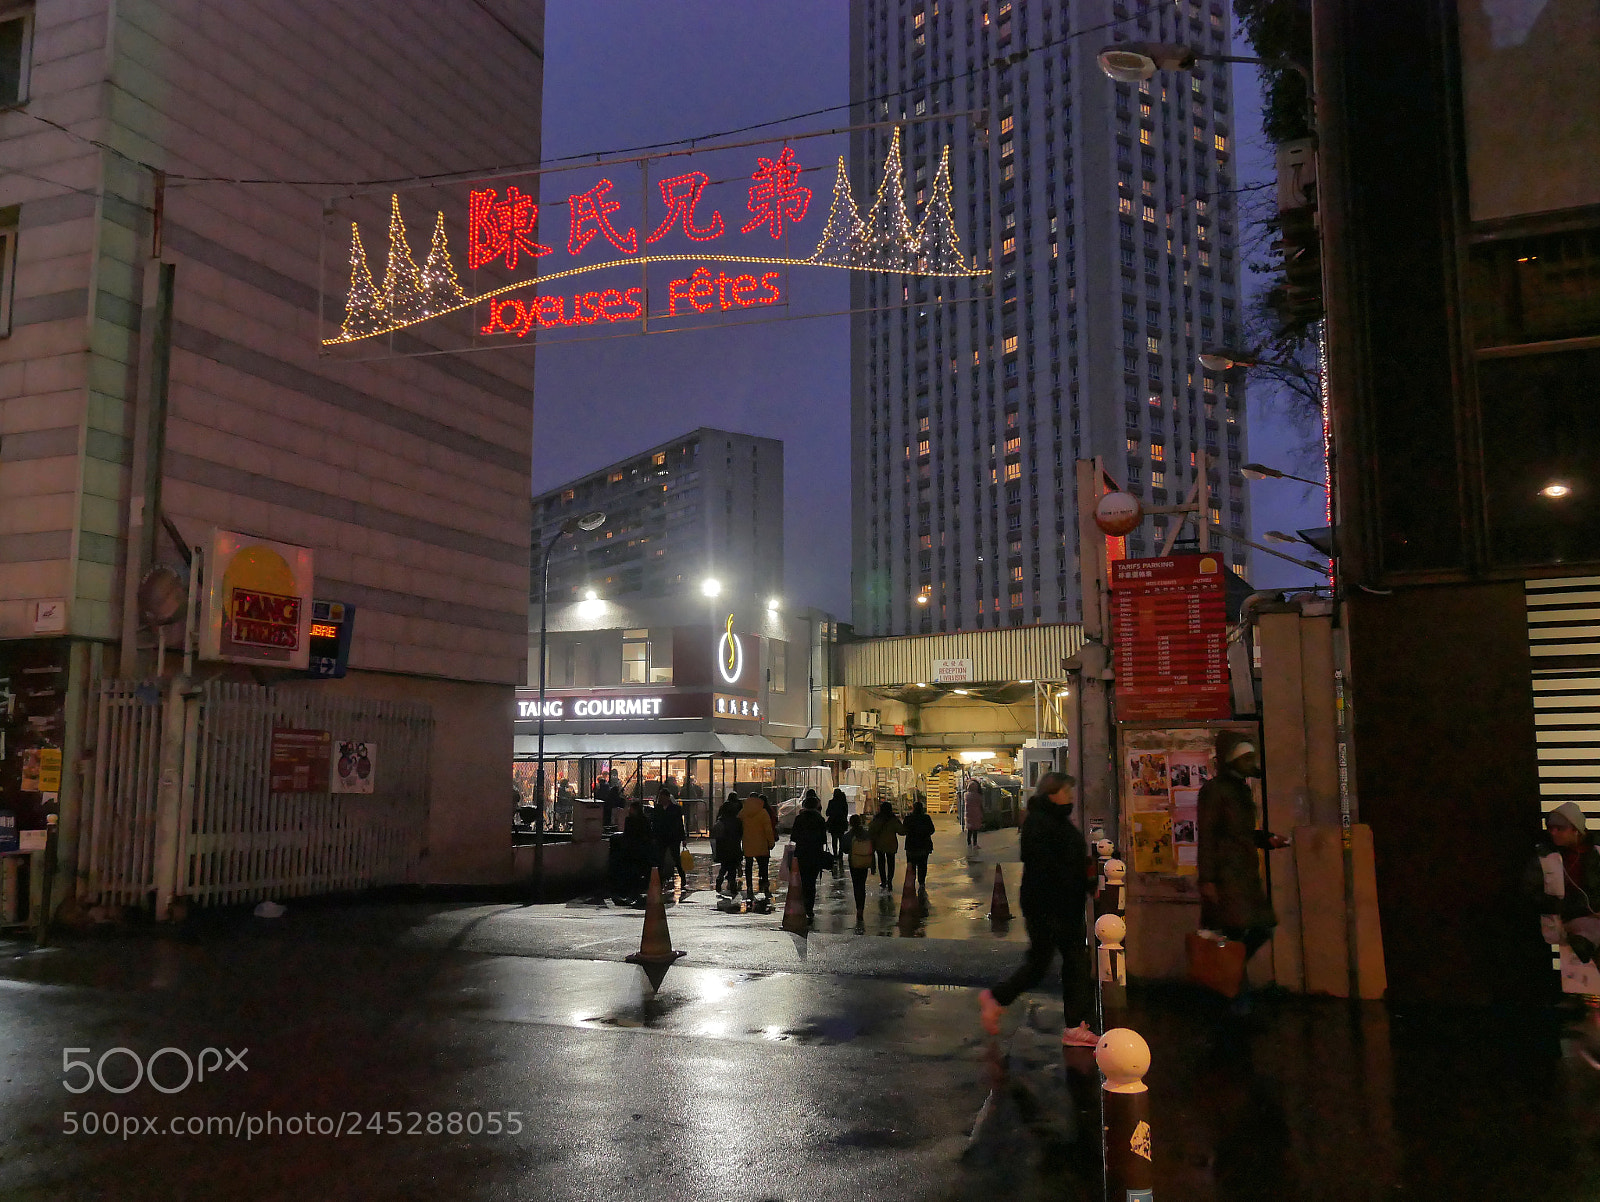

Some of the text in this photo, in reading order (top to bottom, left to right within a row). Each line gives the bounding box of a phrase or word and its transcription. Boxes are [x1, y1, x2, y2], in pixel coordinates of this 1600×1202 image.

[668, 266, 781, 317] Fêtes
[1117, 561, 1175, 571] TARIFS PARKING
[518, 698, 663, 717] TANG GOURMET
